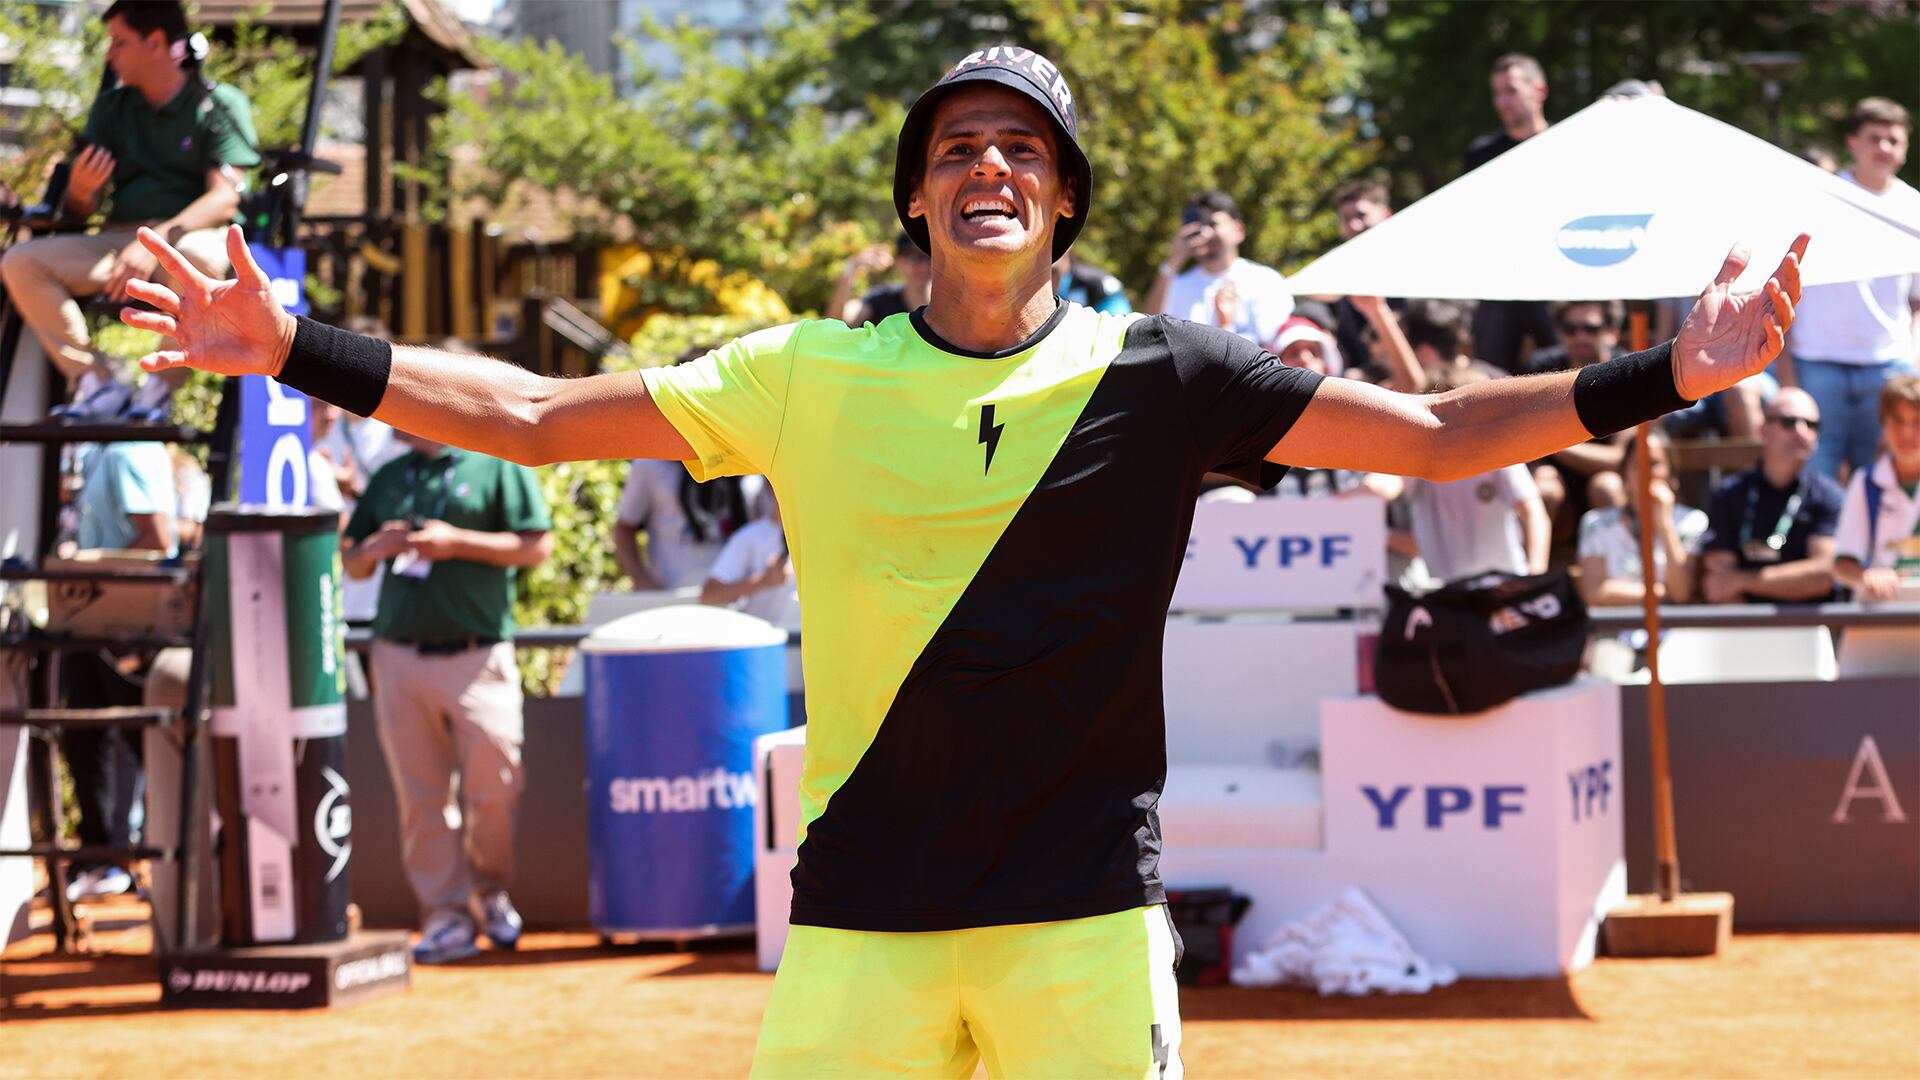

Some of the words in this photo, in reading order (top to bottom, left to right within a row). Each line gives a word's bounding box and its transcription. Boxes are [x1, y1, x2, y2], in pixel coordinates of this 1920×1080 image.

[956, 46, 1072, 114] RIVER
[1233, 534, 1352, 568] YPF
[1568, 760, 1612, 824] YPF
[1829, 733, 1910, 824] A
[1359, 784, 1527, 829] YPF
[192, 969, 312, 994] DUNLOP
